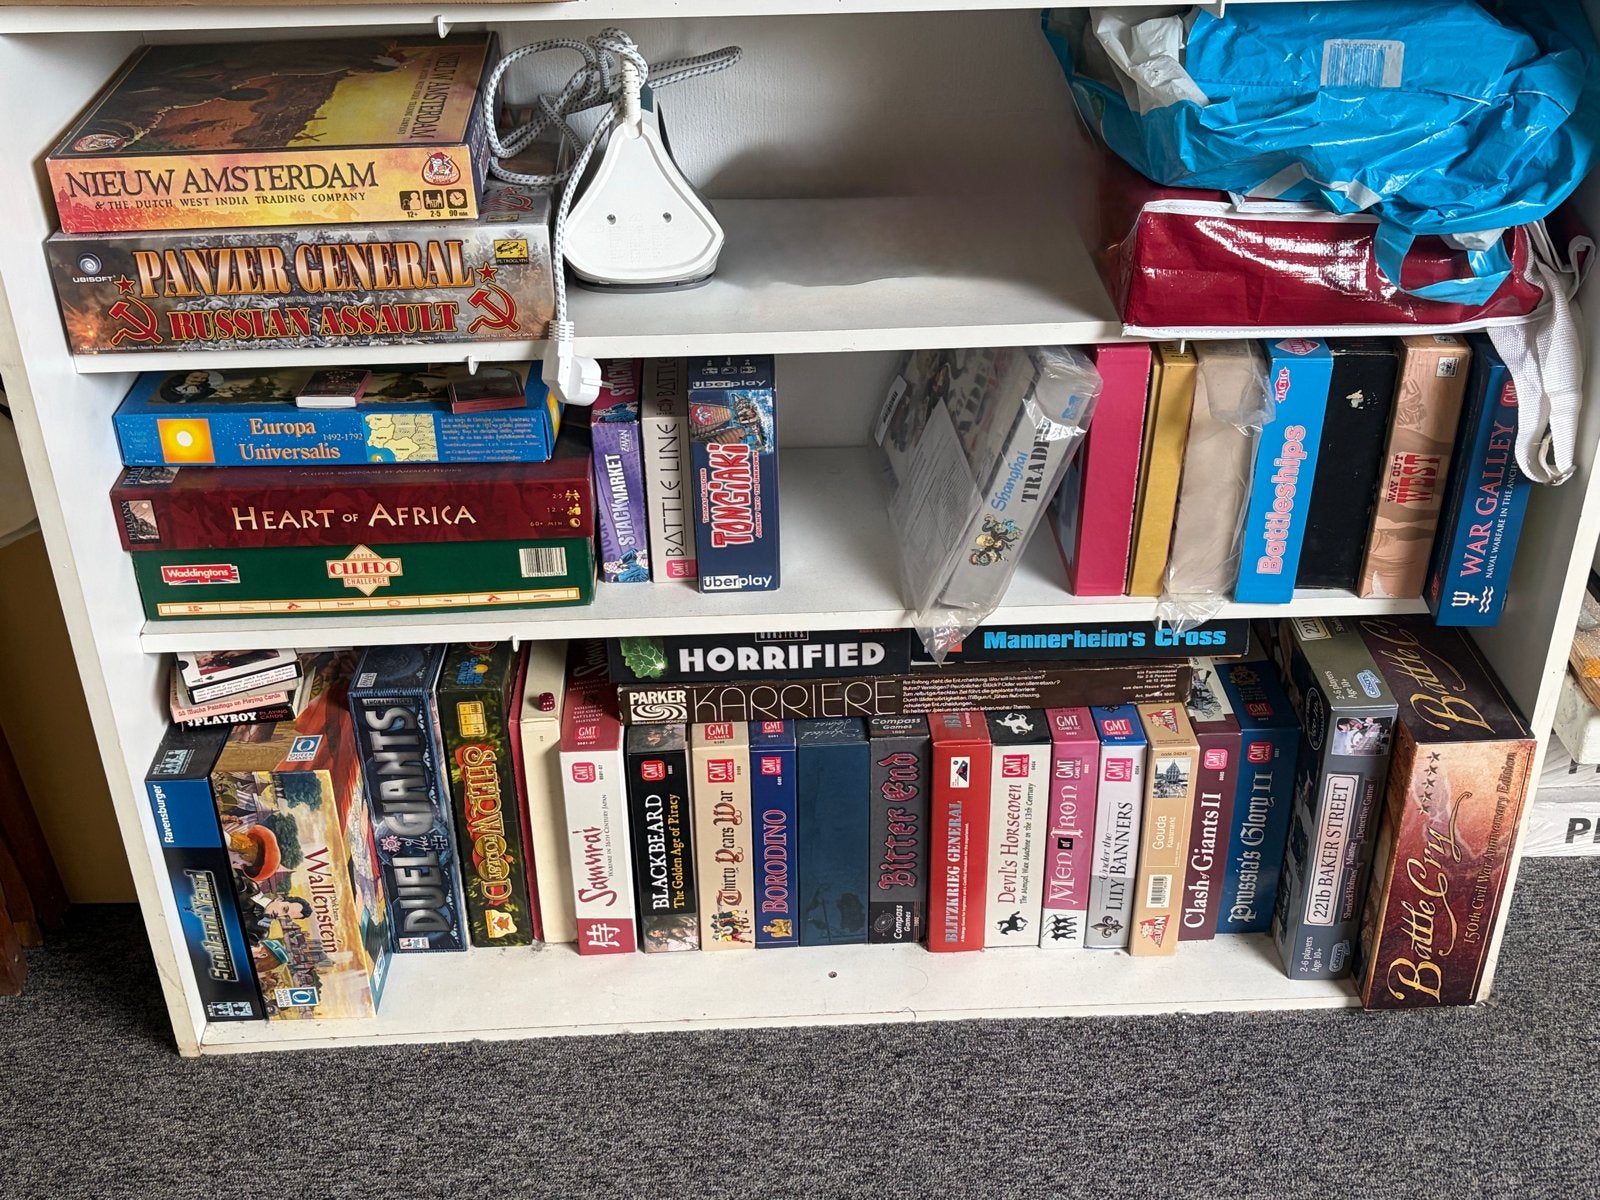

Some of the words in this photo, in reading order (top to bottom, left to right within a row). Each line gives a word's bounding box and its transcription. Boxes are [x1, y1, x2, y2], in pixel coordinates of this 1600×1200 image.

[429, 53, 460, 81] NIEUW
[409, 81, 453, 139] AMSTERDAM
[66, 169, 175, 198] NIEUW
[182, 161, 379, 194] AMSTERDAM
[95, 201, 104, 210] &
[109, 200, 129, 210] THE
[136, 199, 173, 209] DUTCH
[181, 197, 210, 207] WEST
[215, 196, 249, 206] INDIA
[255, 194, 305, 205] TRADING
[311, 192, 366, 202] COMPANY
[72, 275, 113, 284] UBISOFT
[131, 245, 292, 299] PANZER
[294, 239, 475, 294] GENERAL
[166, 306, 311, 342] RUSSIAN
[319, 302, 459, 336] ASSAULT
[1276, 369, 1290, 402] TACTIC
[250, 417, 316, 437] Europa
[322, 431, 364, 442] 1492-1792
[239, 442, 341, 461] Universalis
[656, 423, 681, 478] LINE
[1392, 454, 1404, 477] OUT
[752, 451, 760, 483] UNKNOWN
[990, 450, 1029, 512] Shanghai
[1397, 453, 1441, 504] WEST
[1475, 420, 1515, 517] GALLEY
[605, 454, 636, 547] STACKMARKET
[1256, 424, 1308, 575] Battleships
[1386, 481, 1399, 503] WAY
[1502, 489, 1513, 508] THE
[121, 500, 137, 540] PHALANX
[231, 506, 335, 531] HEART
[368, 503, 477, 527] AFRICA
[660, 480, 686, 557] BATTLE
[1500, 507, 1508, 517] IN
[1493, 516, 1506, 550] WARFARE
[1460, 520, 1493, 578] WAR
[1486, 549, 1498, 579] NAVAL
[166, 567, 229, 579] Waddingtons
[330, 561, 400, 575] CLUEDO
[346, 577, 386, 585] CHALLENGE
[672, 562, 685, 576] GMT
[984, 629, 1146, 649] Mannerheim's
[1155, 629, 1227, 647] Cross
[678, 641, 886, 673] HORRIFIED
[629, 690, 687, 705] PARKER
[694, 680, 896, 722] KARRIERE
[195, 711, 258, 727] PLAYBOY
[707, 724, 730, 736] GMT
[871, 717, 921, 725] Compass
[762, 758, 776, 774] GMT
[1004, 757, 1022, 776] GMT
[1206, 751, 1221, 767] GMT
[1250, 745, 1264, 760] GMT
[365, 707, 435, 837] GIANTS
[575, 763, 588, 780] GMT
[643, 763, 658, 779] GMT
[708, 761, 727, 781] GMT
[878, 753, 920, 802] End
[1056, 760, 1074, 779] GMT
[1106, 758, 1125, 780] GMT
[1253, 771, 1273, 793] II
[1497, 752, 1517, 795] Edition
[669, 794, 681, 824] Piracy
[1027, 782, 1037, 807] Century
[1201, 792, 1221, 808] II
[1362, 783, 1375, 809] Game
[153, 784, 175, 844] Ravensburger
[603, 810, 611, 834] CENTURY
[1000, 783, 1022, 856] Horsemen
[1240, 796, 1275, 847] Glory
[1328, 782, 1351, 840] STREET
[1356, 809, 1369, 840] Detective
[669, 825, 681, 836] of
[947, 800, 963, 863] GENERAL
[1104, 831, 1114, 846] the
[1110, 801, 1133, 877] BANNERS
[1152, 815, 1168, 850] Gouda
[1191, 810, 1220, 871] Giants
[1482, 796, 1506, 862] Anniversary
[645, 794, 670, 910] BLACKBEARD
[670, 837, 685, 853] Age
[877, 808, 919, 891] Bitter
[1346, 841, 1358, 866] Master
[572, 826, 618, 907] Samurai
[671, 855, 685, 890] Golden
[762, 809, 789, 914] BORODINO
[1100, 846, 1111, 881] Under
[1320, 840, 1340, 888] BAKER
[1407, 791, 1473, 957] Cry
[1477, 861, 1492, 886] War
[392, 850, 450, 932] DUEL
[715, 867, 743, 906] Thirty
[997, 860, 1018, 904] Devil's
[1020, 874, 1029, 893] Mongol
[1048, 852, 1078, 905] Men
[1202, 872, 1210, 882] of
[1227, 851, 1262, 923] Prussia's
[304, 847, 338, 954] Wallenstein
[673, 891, 686, 909] The
[945, 865, 961, 943] BLITZKRIEG
[1019, 894, 1028, 905] The
[1106, 878, 1125, 912] LILY
[1184, 885, 1210, 928] Clash
[1343, 890, 1353, 920] Sherlock
[1472, 884, 1487, 910] Civil
[586, 922, 621, 948] 侍
[893, 904, 903, 940] Compass
[1463, 910, 1483, 945] 150th
[1303, 936, 1315, 960] players
[1312, 946, 1323, 960] 10+
[1386, 899, 1442, 1004] Battle
[1299, 957, 1310, 972] 2-6
[1311, 959, 1322, 973] Age
